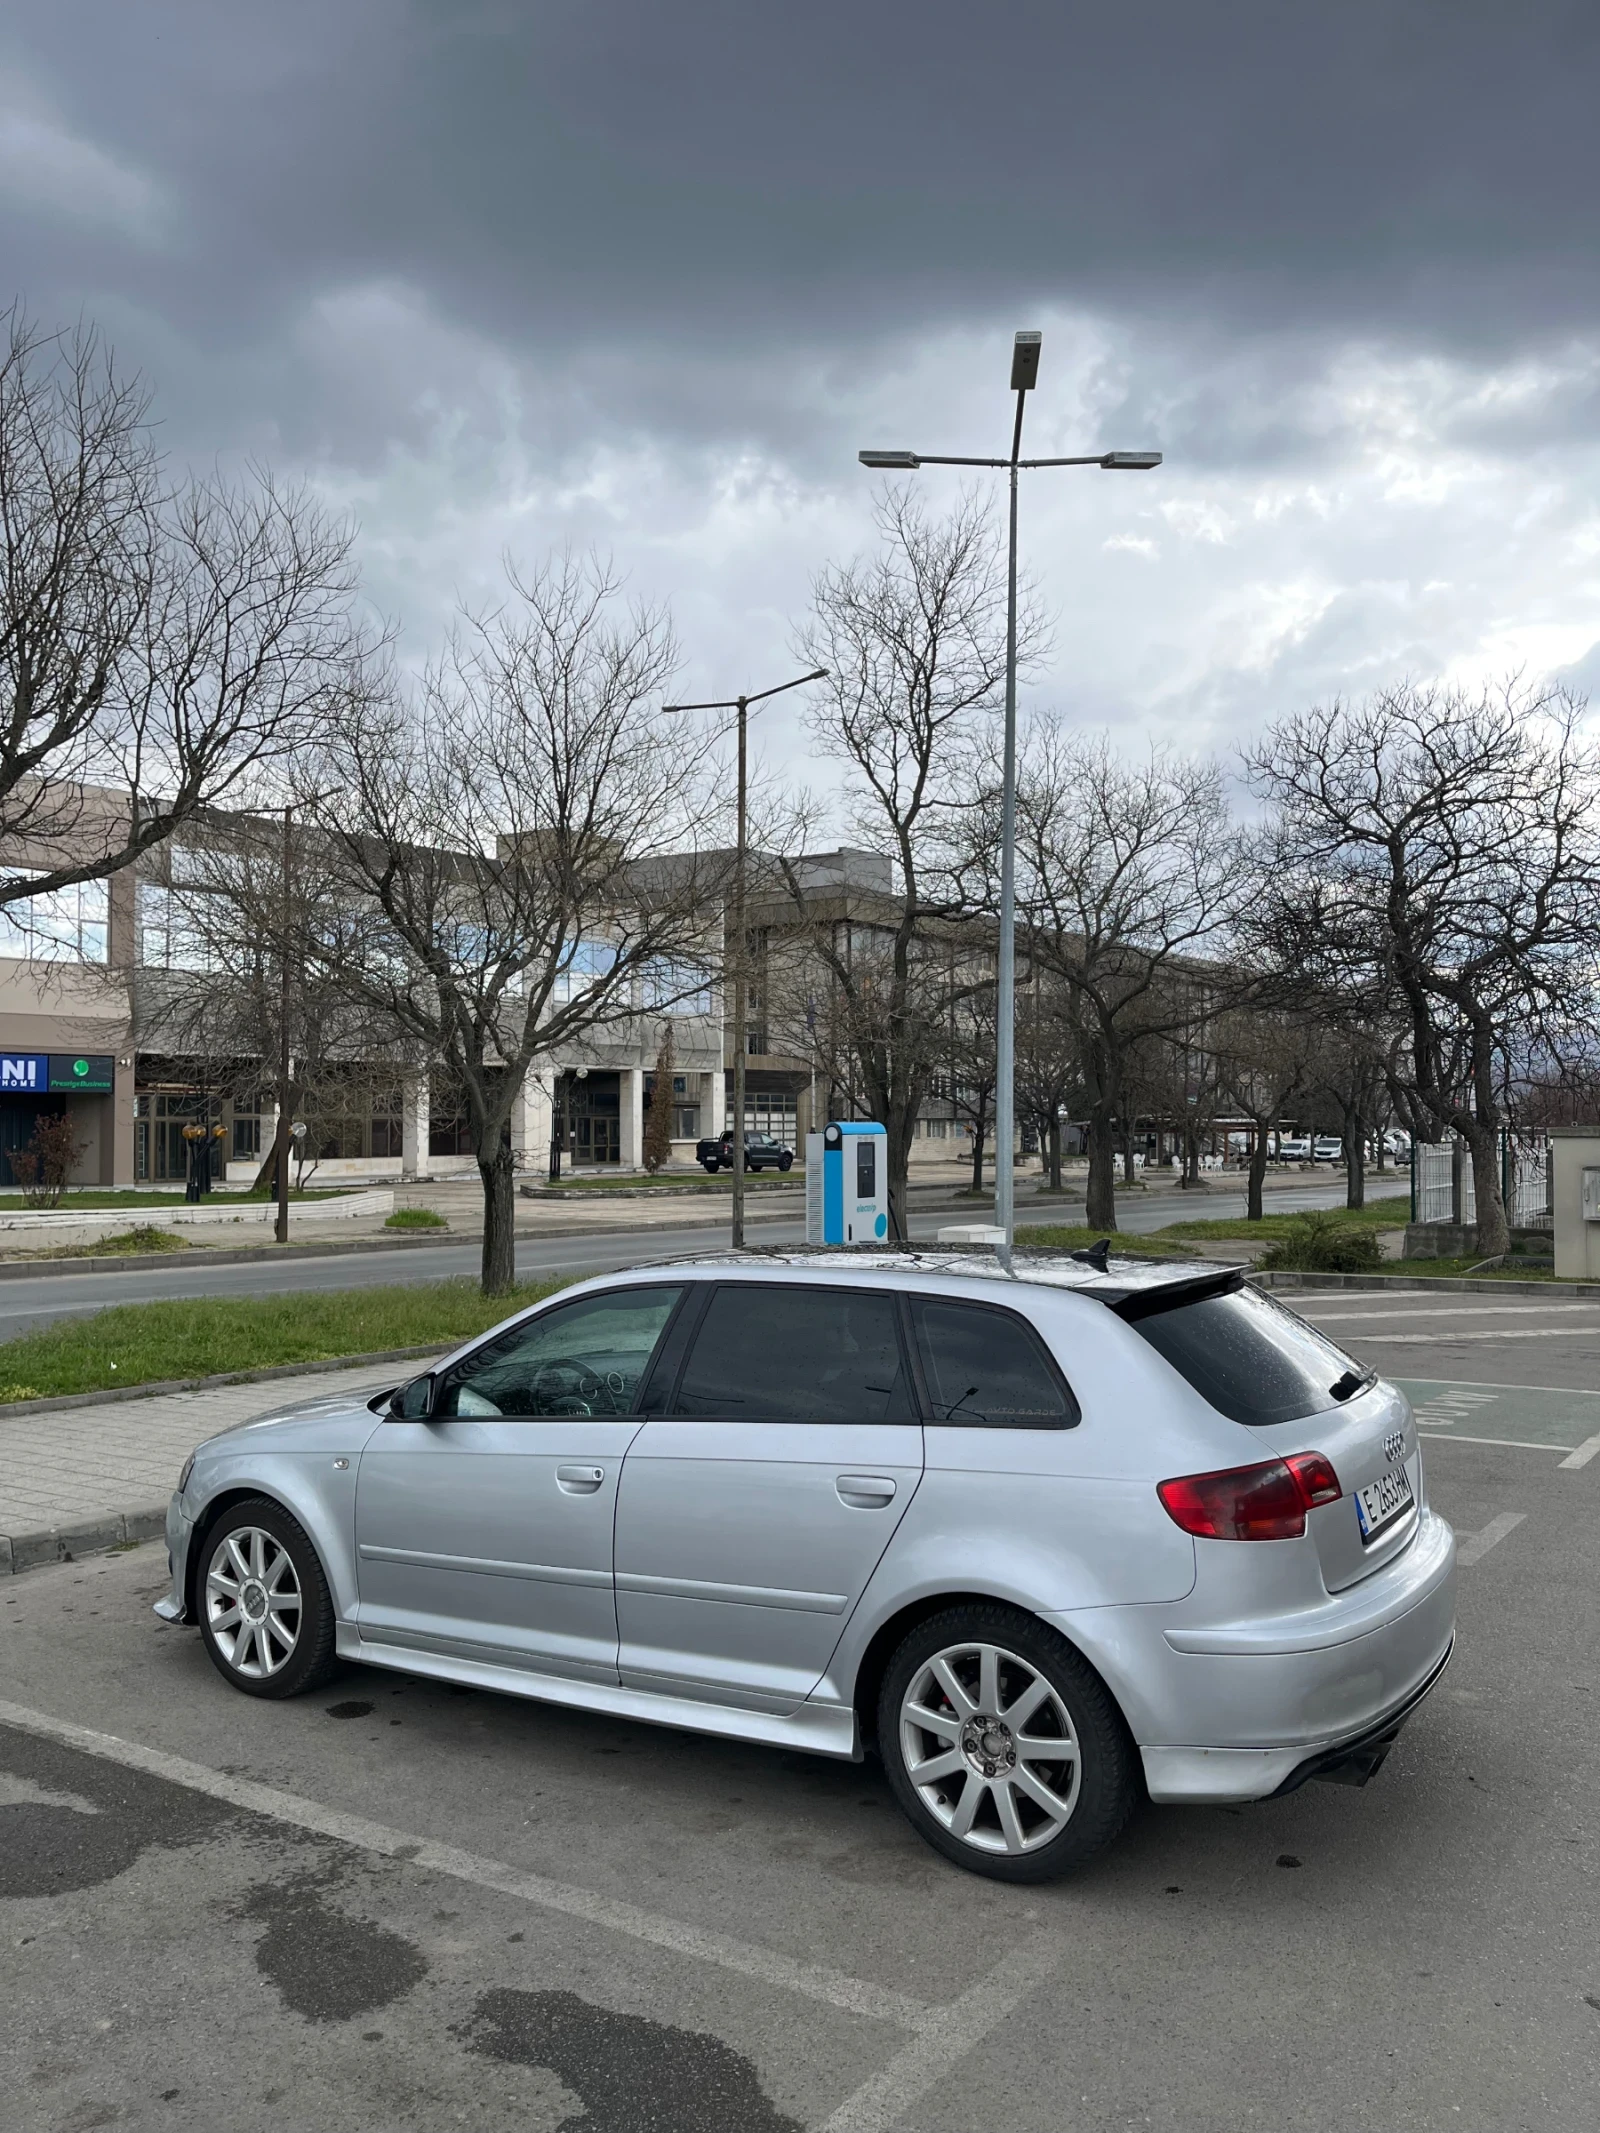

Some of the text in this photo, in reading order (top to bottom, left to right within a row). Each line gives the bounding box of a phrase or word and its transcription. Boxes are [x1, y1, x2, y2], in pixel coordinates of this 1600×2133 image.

[0, 1059, 36, 1080] NI
[2, 1079, 36, 1087] HOME
[1018, 1408, 1056, 1416] GARDE
[1362, 1489, 1378, 1523] E
